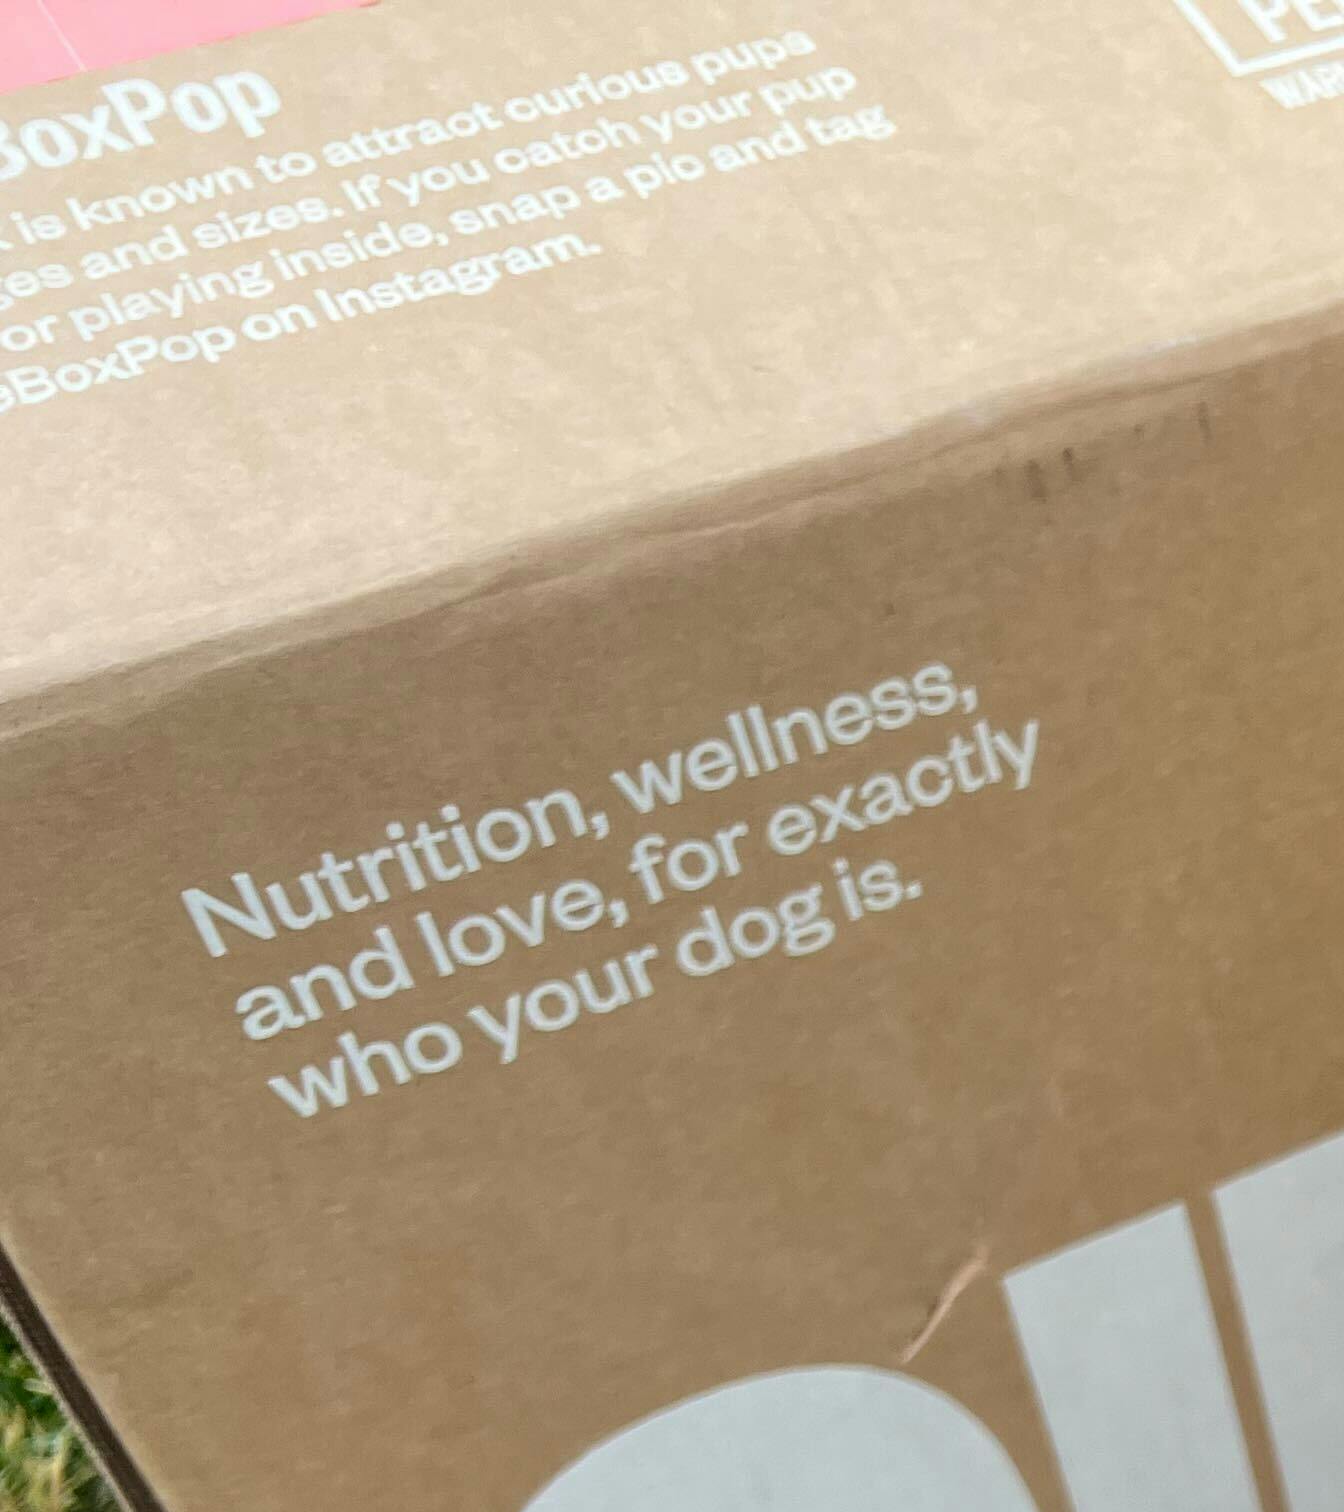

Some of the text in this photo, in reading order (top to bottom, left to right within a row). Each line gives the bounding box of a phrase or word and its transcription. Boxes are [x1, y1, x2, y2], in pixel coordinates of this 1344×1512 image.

[10, 210, 67, 245] is
[66, 166, 255, 231] known
[254, 151, 317, 183] to
[322, 102, 504, 167] attract
[504, 60, 690, 123] curious
[690, 30, 817, 86] pups
[67, 260, 275, 342] playing
[268, 220, 450, 281] inside,
[449, 184, 582, 236] snap
[584, 174, 626, 203] a
[622, 151, 706, 199] pic
[707, 119, 809, 173] and
[803, 104, 898, 147] tag
[79, 224, 190, 280] and
[191, 197, 345, 250] sizes.
[341, 173, 381, 211] If
[385, 158, 490, 208] you
[494, 115, 642, 174] catch
[639, 90, 752, 145] your
[757, 65, 858, 117] pup
[241, 302, 318, 342] on
[313, 233, 604, 322] Instagram.
[180, 661, 979, 959] Nutrition, wellness,
[234, 718, 1040, 1041] and love, for exactly
[266, 857, 925, 1119] who your dog is.
